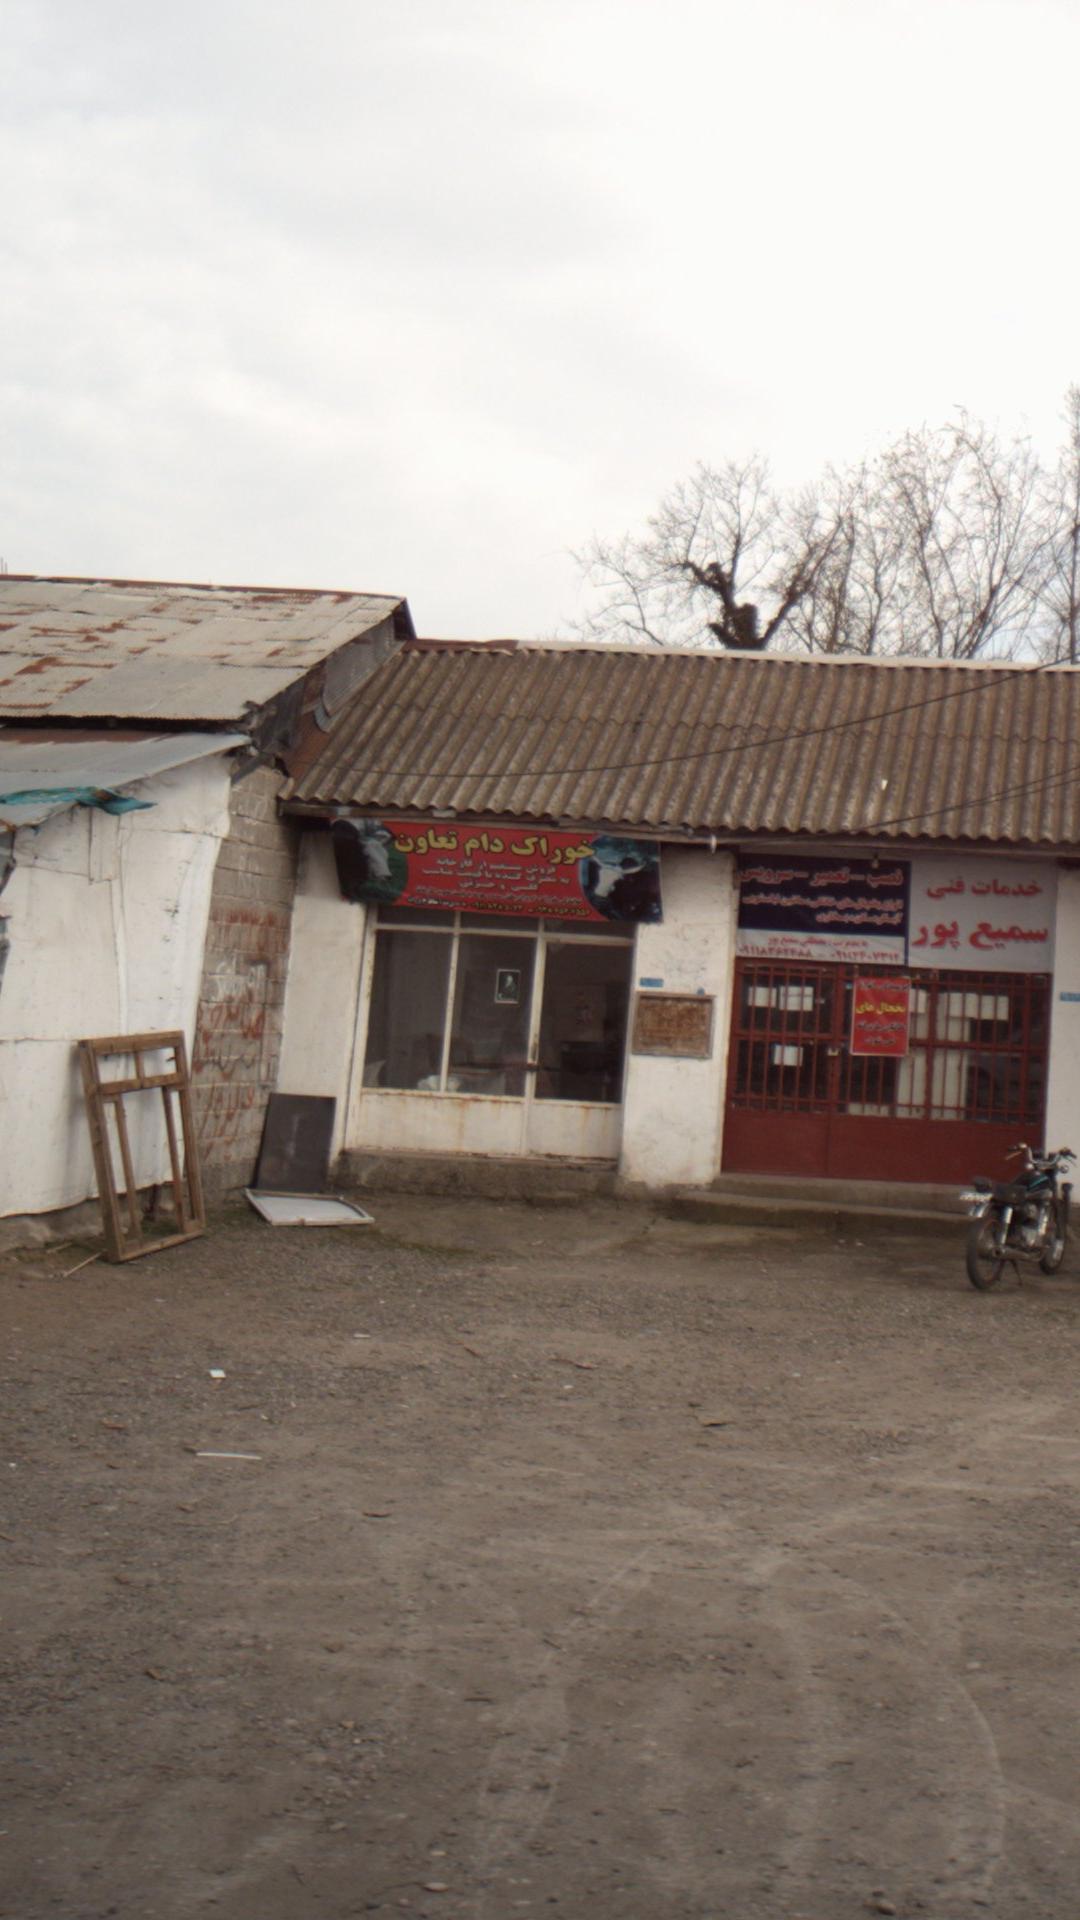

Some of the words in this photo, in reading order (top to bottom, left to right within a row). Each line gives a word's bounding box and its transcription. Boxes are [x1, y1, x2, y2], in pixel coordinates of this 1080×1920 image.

[394, 828, 458, 854] تعاون
[464, 832, 504, 856] دام
[511, 836, 595, 864] خوراک
[739, 866, 795, 885] سرویس
[809, 866, 851, 887] تعمیر
[867, 868, 904, 888] نصب
[926, 875, 966, 899] فنی
[971, 879, 1043, 897] خدمات
[911, 920, 960, 949] پور
[968, 921, 1050, 950] سمیع
